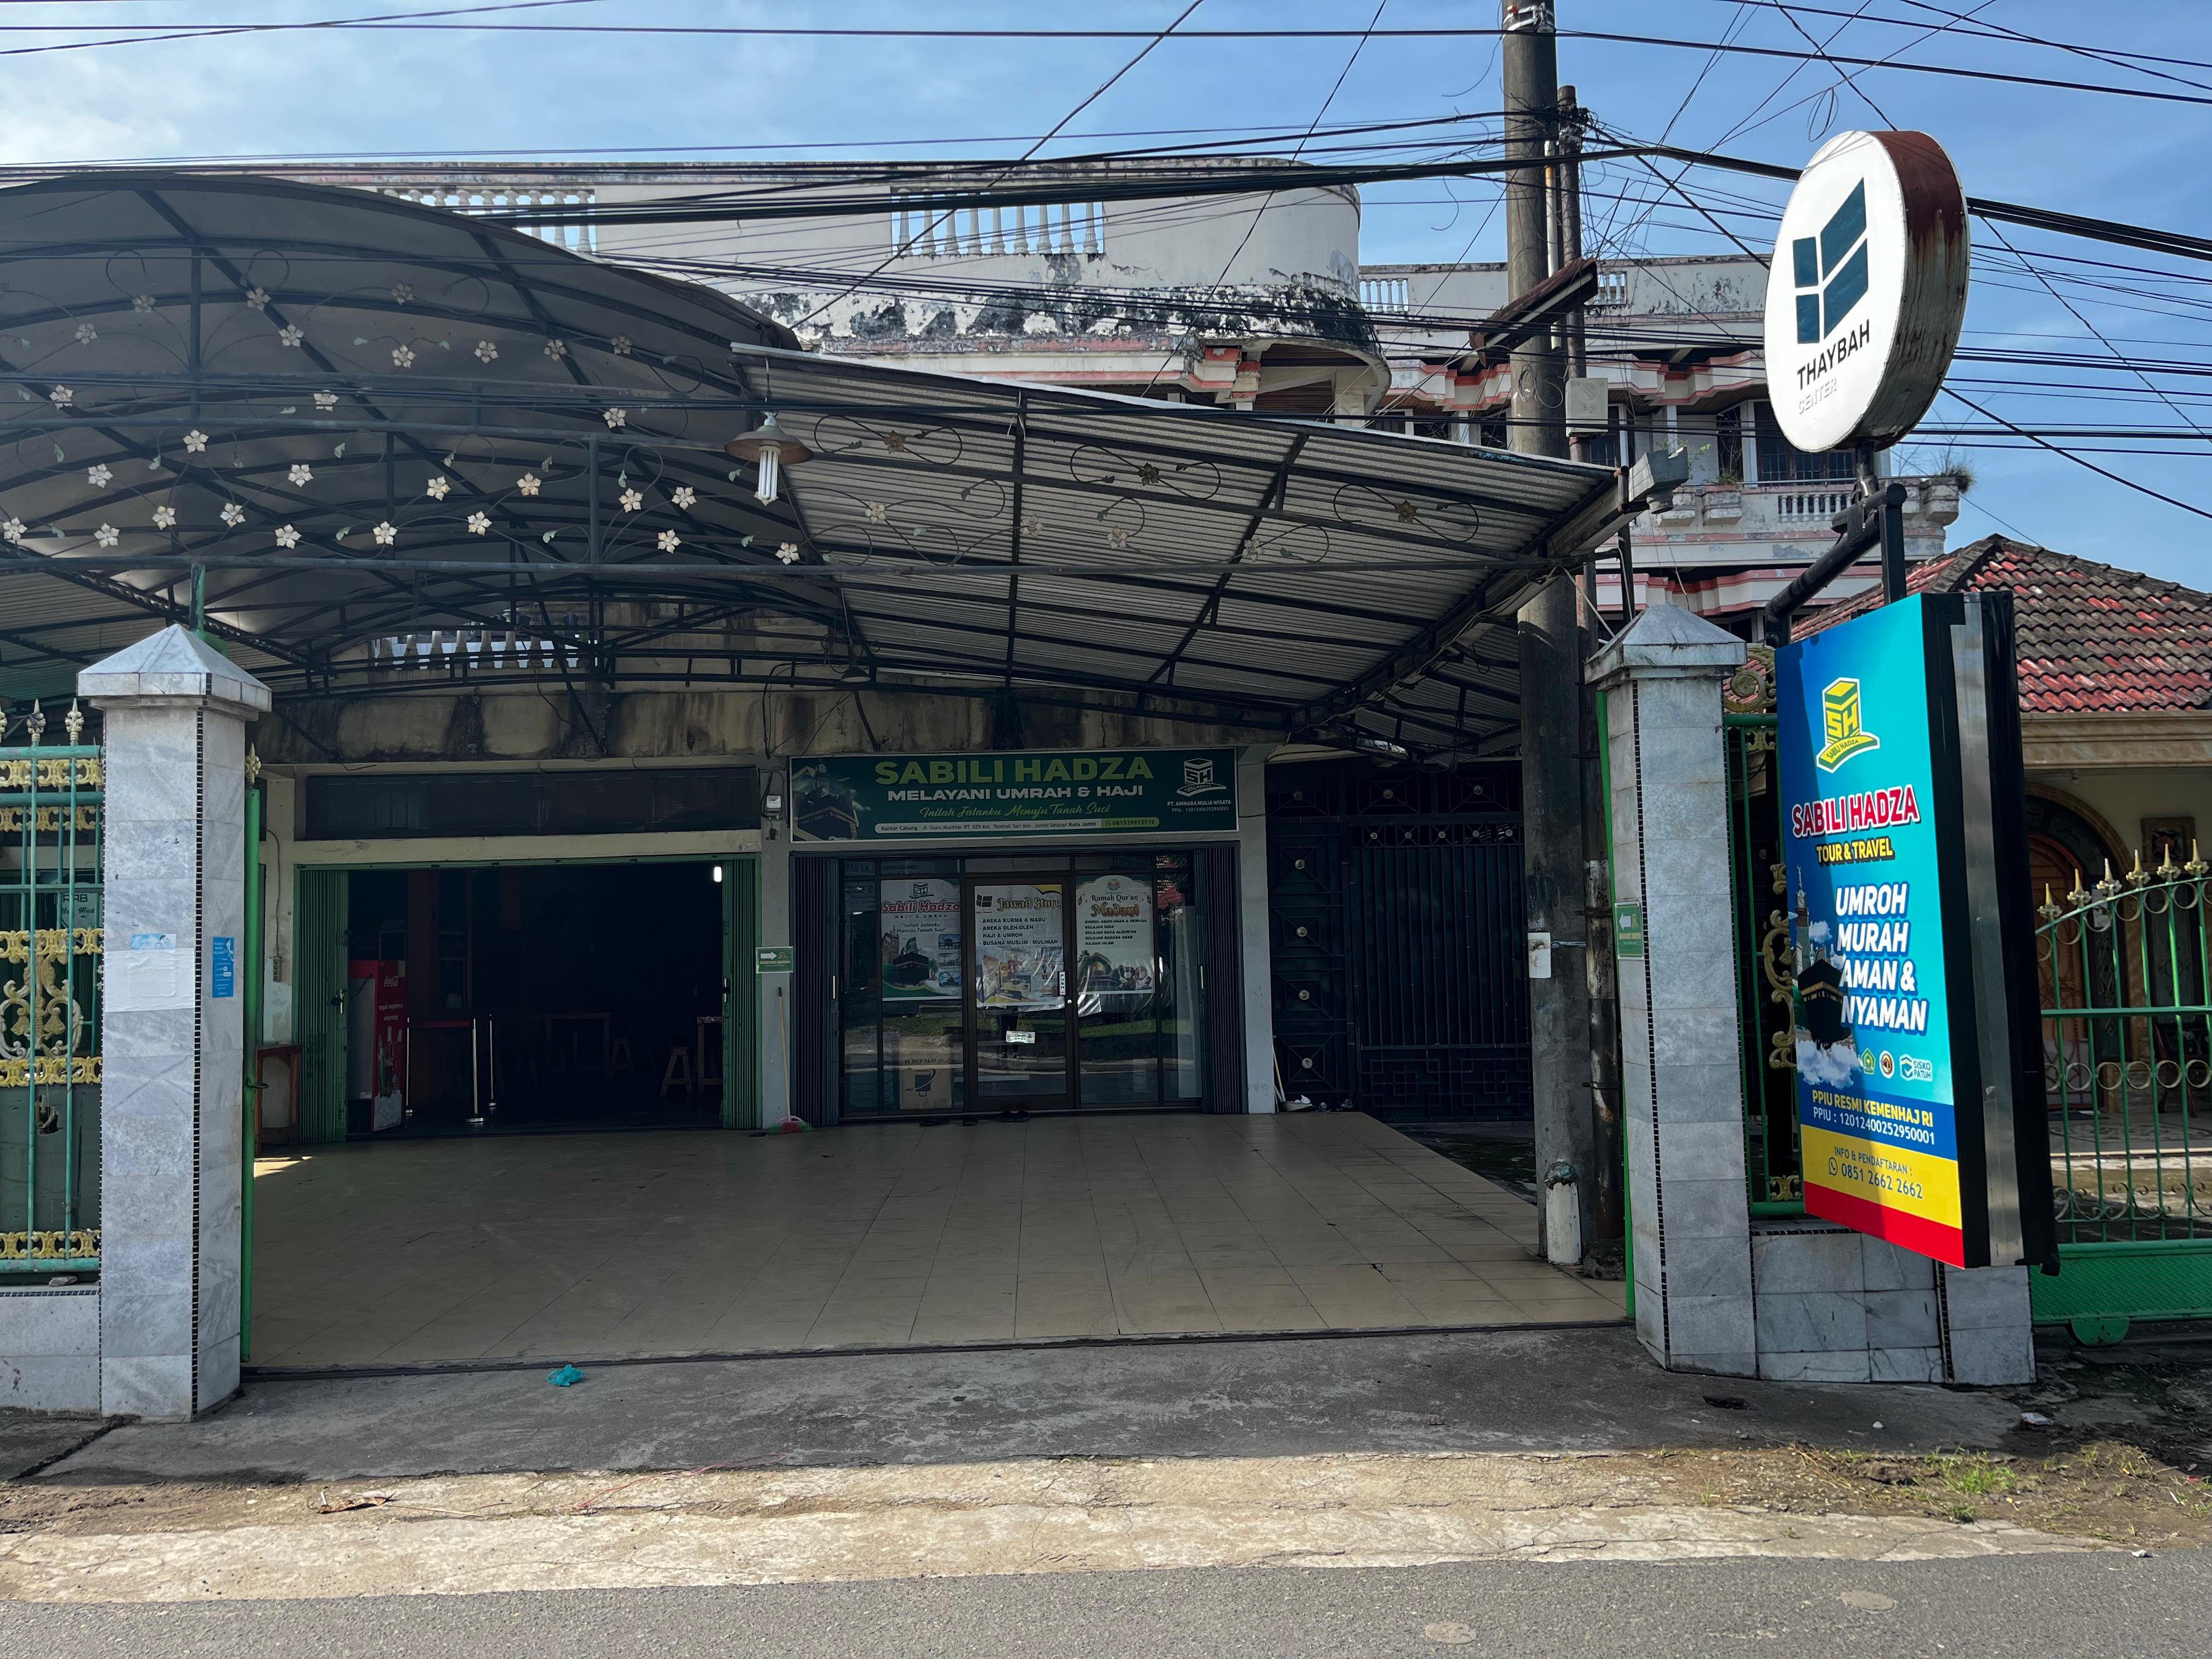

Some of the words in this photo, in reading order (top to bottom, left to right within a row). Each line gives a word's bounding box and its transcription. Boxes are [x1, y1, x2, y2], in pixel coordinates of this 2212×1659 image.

[1797, 319, 1870, 390] THAYBAH
[1798, 377, 1837, 415] CENTER
[1826, 702, 1858, 738] SH
[1826, 743, 1841, 759] SABILI
[1839, 739, 1859, 751] HADZA
[875, 760, 1003, 785] SABILI
[1015, 757, 1154, 782] HADZA
[888, 789, 990, 801] MELAYANI
[996, 787, 1071, 799] UMRAH
[1078, 787, 1090, 797] &
[1097, 785, 1143, 797] HAJI
[920, 806, 955, 819] Inilah
[957, 805, 1001, 818] Jalanku
[1004, 804, 1048, 820] Menuju
[1049, 803, 1084, 815] Tanah
[1086, 802, 1110, 815] Suci
[1792, 798, 1847, 837] SABILI
[1849, 786, 1920, 830] HADZA
[1816, 843, 1842, 863] TOUR
[1844, 842, 1851, 860] &
[1852, 838, 1893, 860] TRAVEL
[882, 901, 917, 913] Sabili
[918, 900, 961, 912] Hadza
[997, 897, 1032, 911] Jawad
[1033, 897, 1063, 910] Store
[1090, 901, 1140, 917] Madani
[1116, 894, 1138, 902] Qur'an
[1835, 883, 1907, 916] UMROH
[1837, 922, 1909, 952] MURAH
[1839, 959, 1898, 990] AMAN
[1900, 961, 1915, 991] &
[1841, 995, 1927, 1031] NYAMAN
[1913, 1060, 1931, 1070] SISKO
[1914, 1069, 1931, 1079] PATUH
[1812, 1090, 1833, 1106] PPIU
[1835, 1093, 1862, 1113] RESMI
[1864, 1099, 1920, 1125] KEMENHAJ
[1922, 1111, 1933, 1127] RI
[1813, 1107, 1831, 1121] PPIU
[1840, 1113, 1934, 1145] 12012400252950001
[1835, 1146, 1849, 1159] INFO
[1852, 1150, 1857, 1161] &
[1858, 1153, 1908, 1175] PENDAFTARAN
[1841, 1163, 1864, 1182] 0851
[1869, 1170, 1893, 1190] 2662
[1898, 1178, 1923, 1199] 2662
